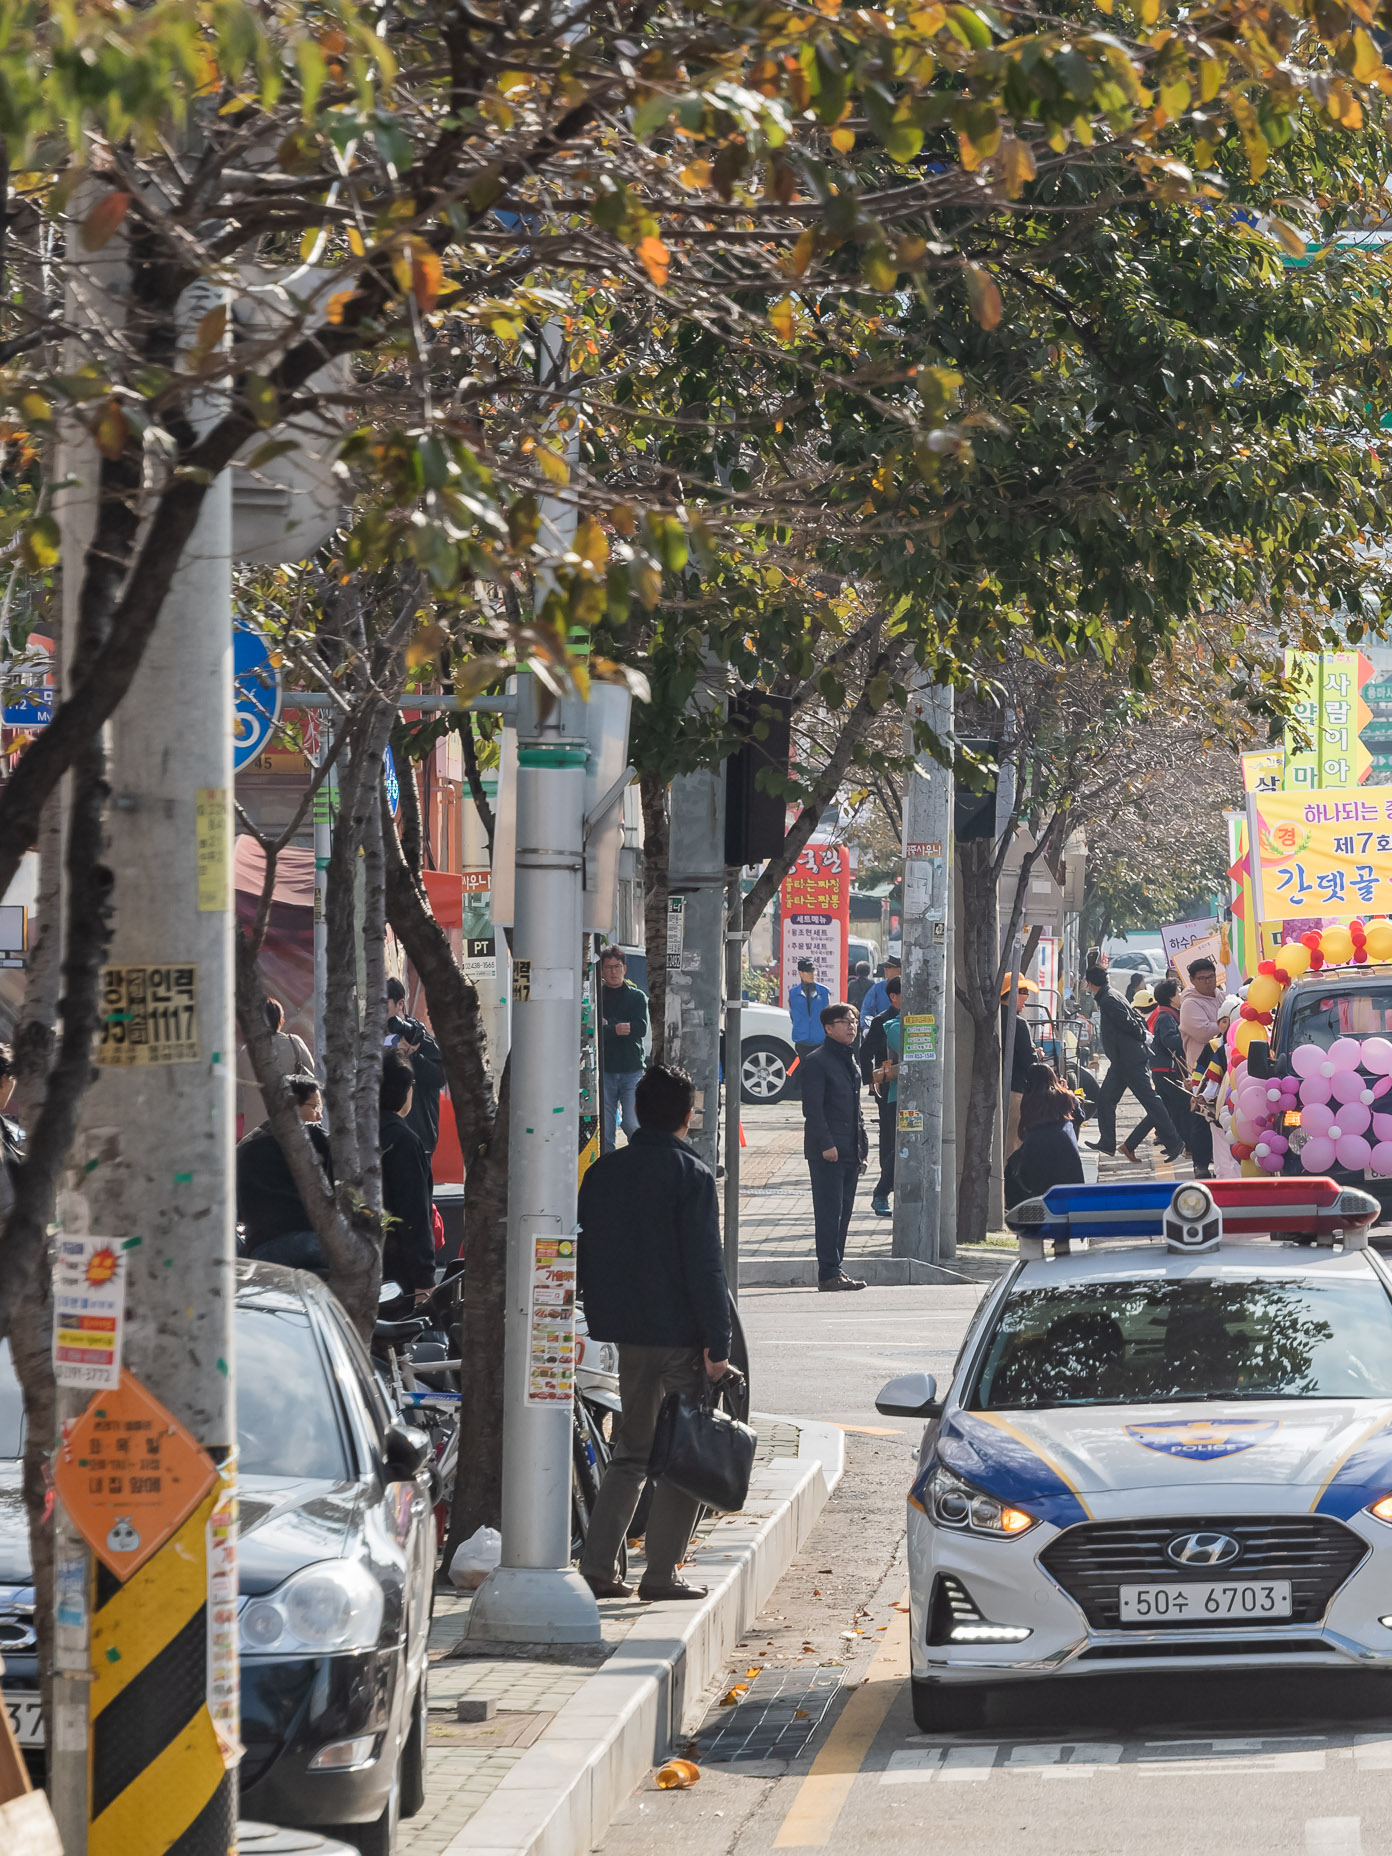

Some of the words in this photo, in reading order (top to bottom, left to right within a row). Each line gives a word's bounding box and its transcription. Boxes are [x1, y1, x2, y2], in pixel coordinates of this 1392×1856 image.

[1304, 802, 1379, 824] 하나되는
[1278, 828, 1296, 847] 경
[796, 916, 827, 924] 세트메뉴
[474, 940, 489, 955] PT
[151, 967, 194, 1002] 인력
[151, 1005, 194, 1040] 1117
[1171, 1444, 1237, 1453] POLICE
[1136, 1589, 1190, 1616] 50수
[1204, 1586, 1276, 1614] 6703
